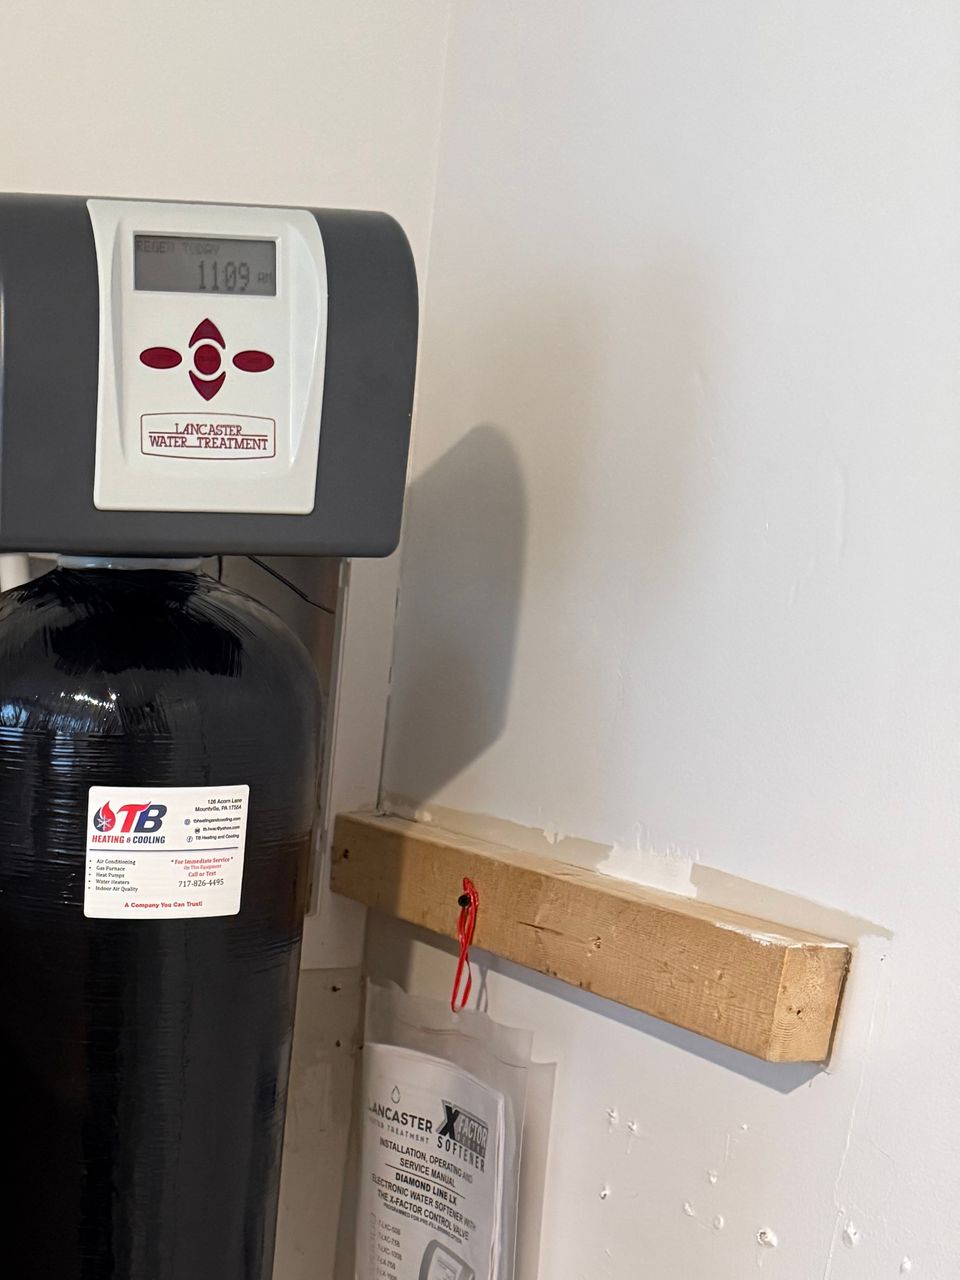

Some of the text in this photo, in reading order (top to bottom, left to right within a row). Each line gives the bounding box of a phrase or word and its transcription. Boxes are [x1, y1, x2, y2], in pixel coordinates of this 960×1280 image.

[148, 435, 269, 450] WATER TREATMENT
[174, 423, 242, 436] LANCASTER
[116, 801, 167, 833] TB
[92, 835, 124, 844] HEATING
[132, 835, 166, 844] COOLING
[178, 878, 225, 888] 717-826-4495
[387, 1124, 429, 1144] TREATMENT
[380, 1137, 428, 1163] INSTALLATION,
[429, 1155, 462, 1179] OPERATING
[436, 1135, 485, 1173] SOFTENER
[399, 1157, 456, 1188] SERVICE MANUAL
[371, 1172, 477, 1232] ELECTRONIC WATER SOFTENER WITH
[395, 1172, 458, 1206] DIAMOND LINE LX
[377, 1188, 471, 1241] THE X-FACTOR CONTROL VALVE
